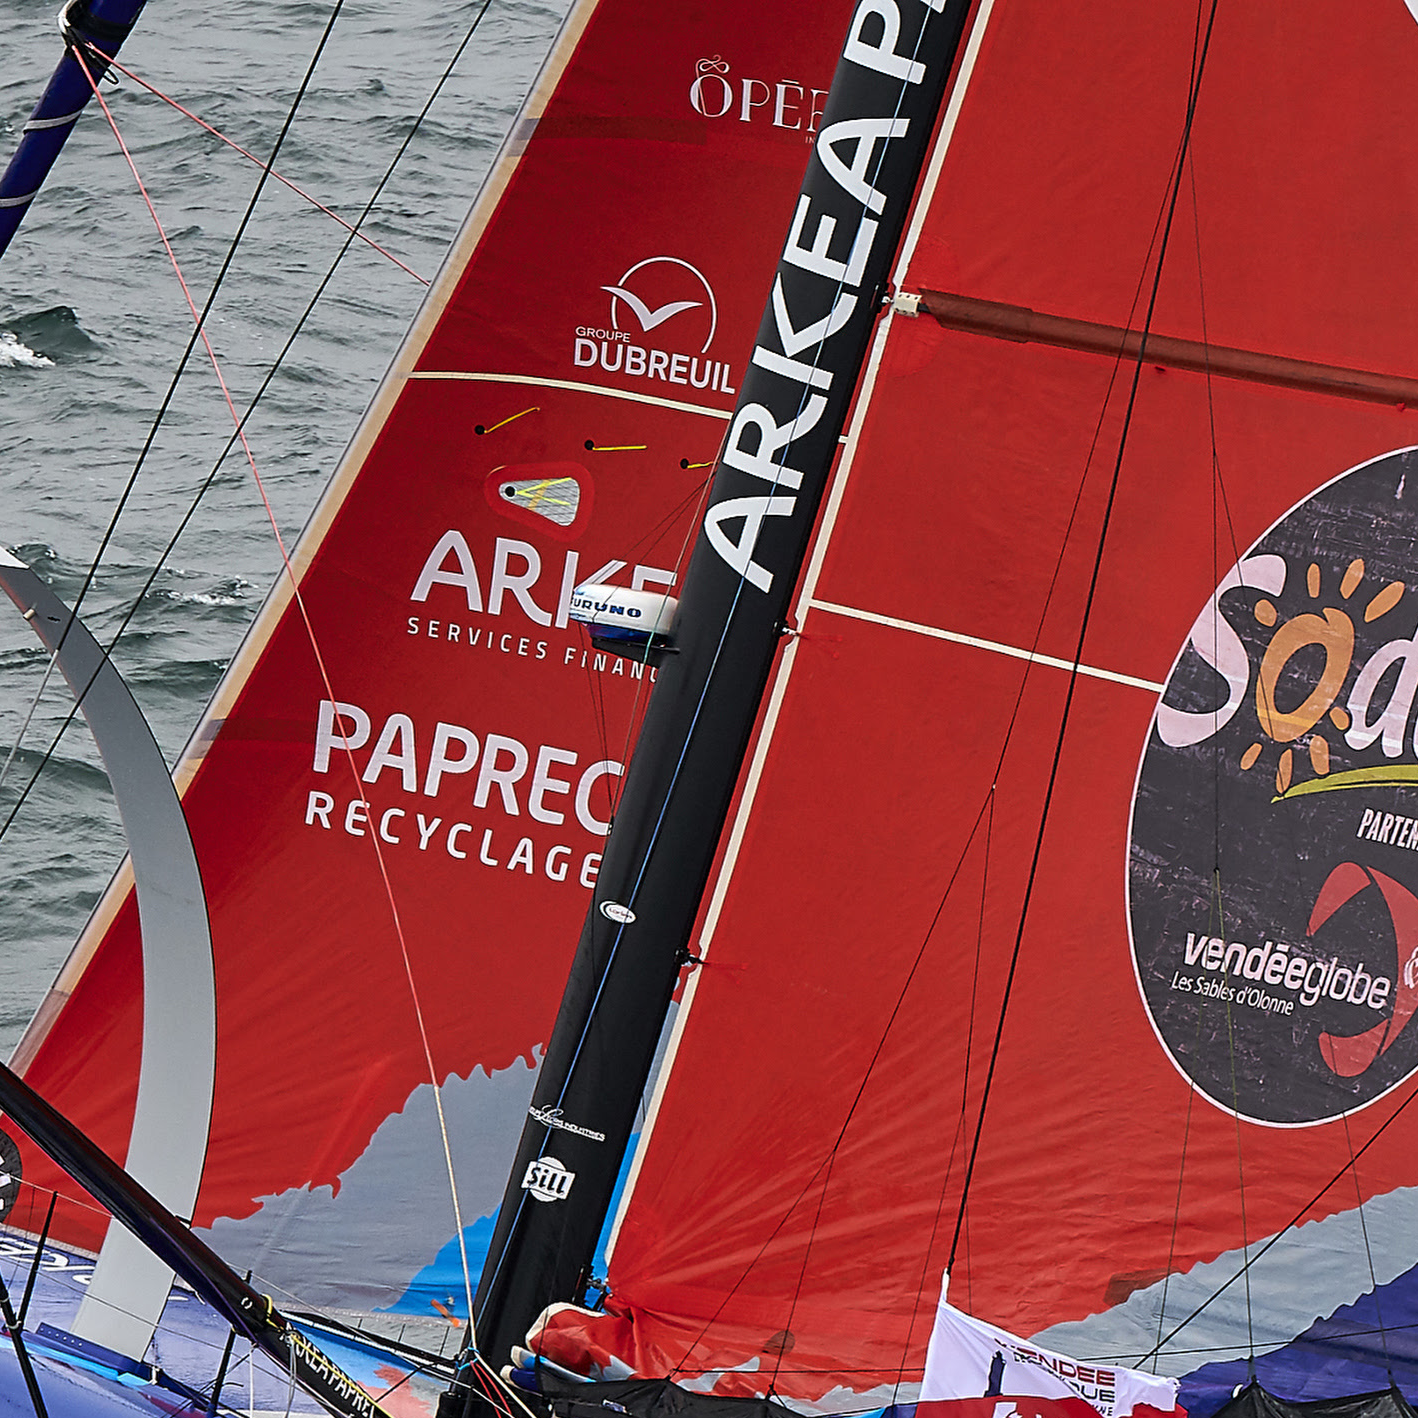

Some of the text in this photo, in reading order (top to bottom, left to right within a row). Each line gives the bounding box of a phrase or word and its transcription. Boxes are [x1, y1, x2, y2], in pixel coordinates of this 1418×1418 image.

[575, 326, 631, 343] GROUPE
[703, 117, 911, 594] ARKEA
[573, 337, 736, 395] DUBREUIL
[407, 616, 548, 660] SERVICES
[312, 699, 625, 836] PAPREC
[304, 790, 603, 889] RECYCLAGE
[1171, 970, 1295, 1016] Les Sables d'Olonne
[526, 1167, 568, 1194] Sill
